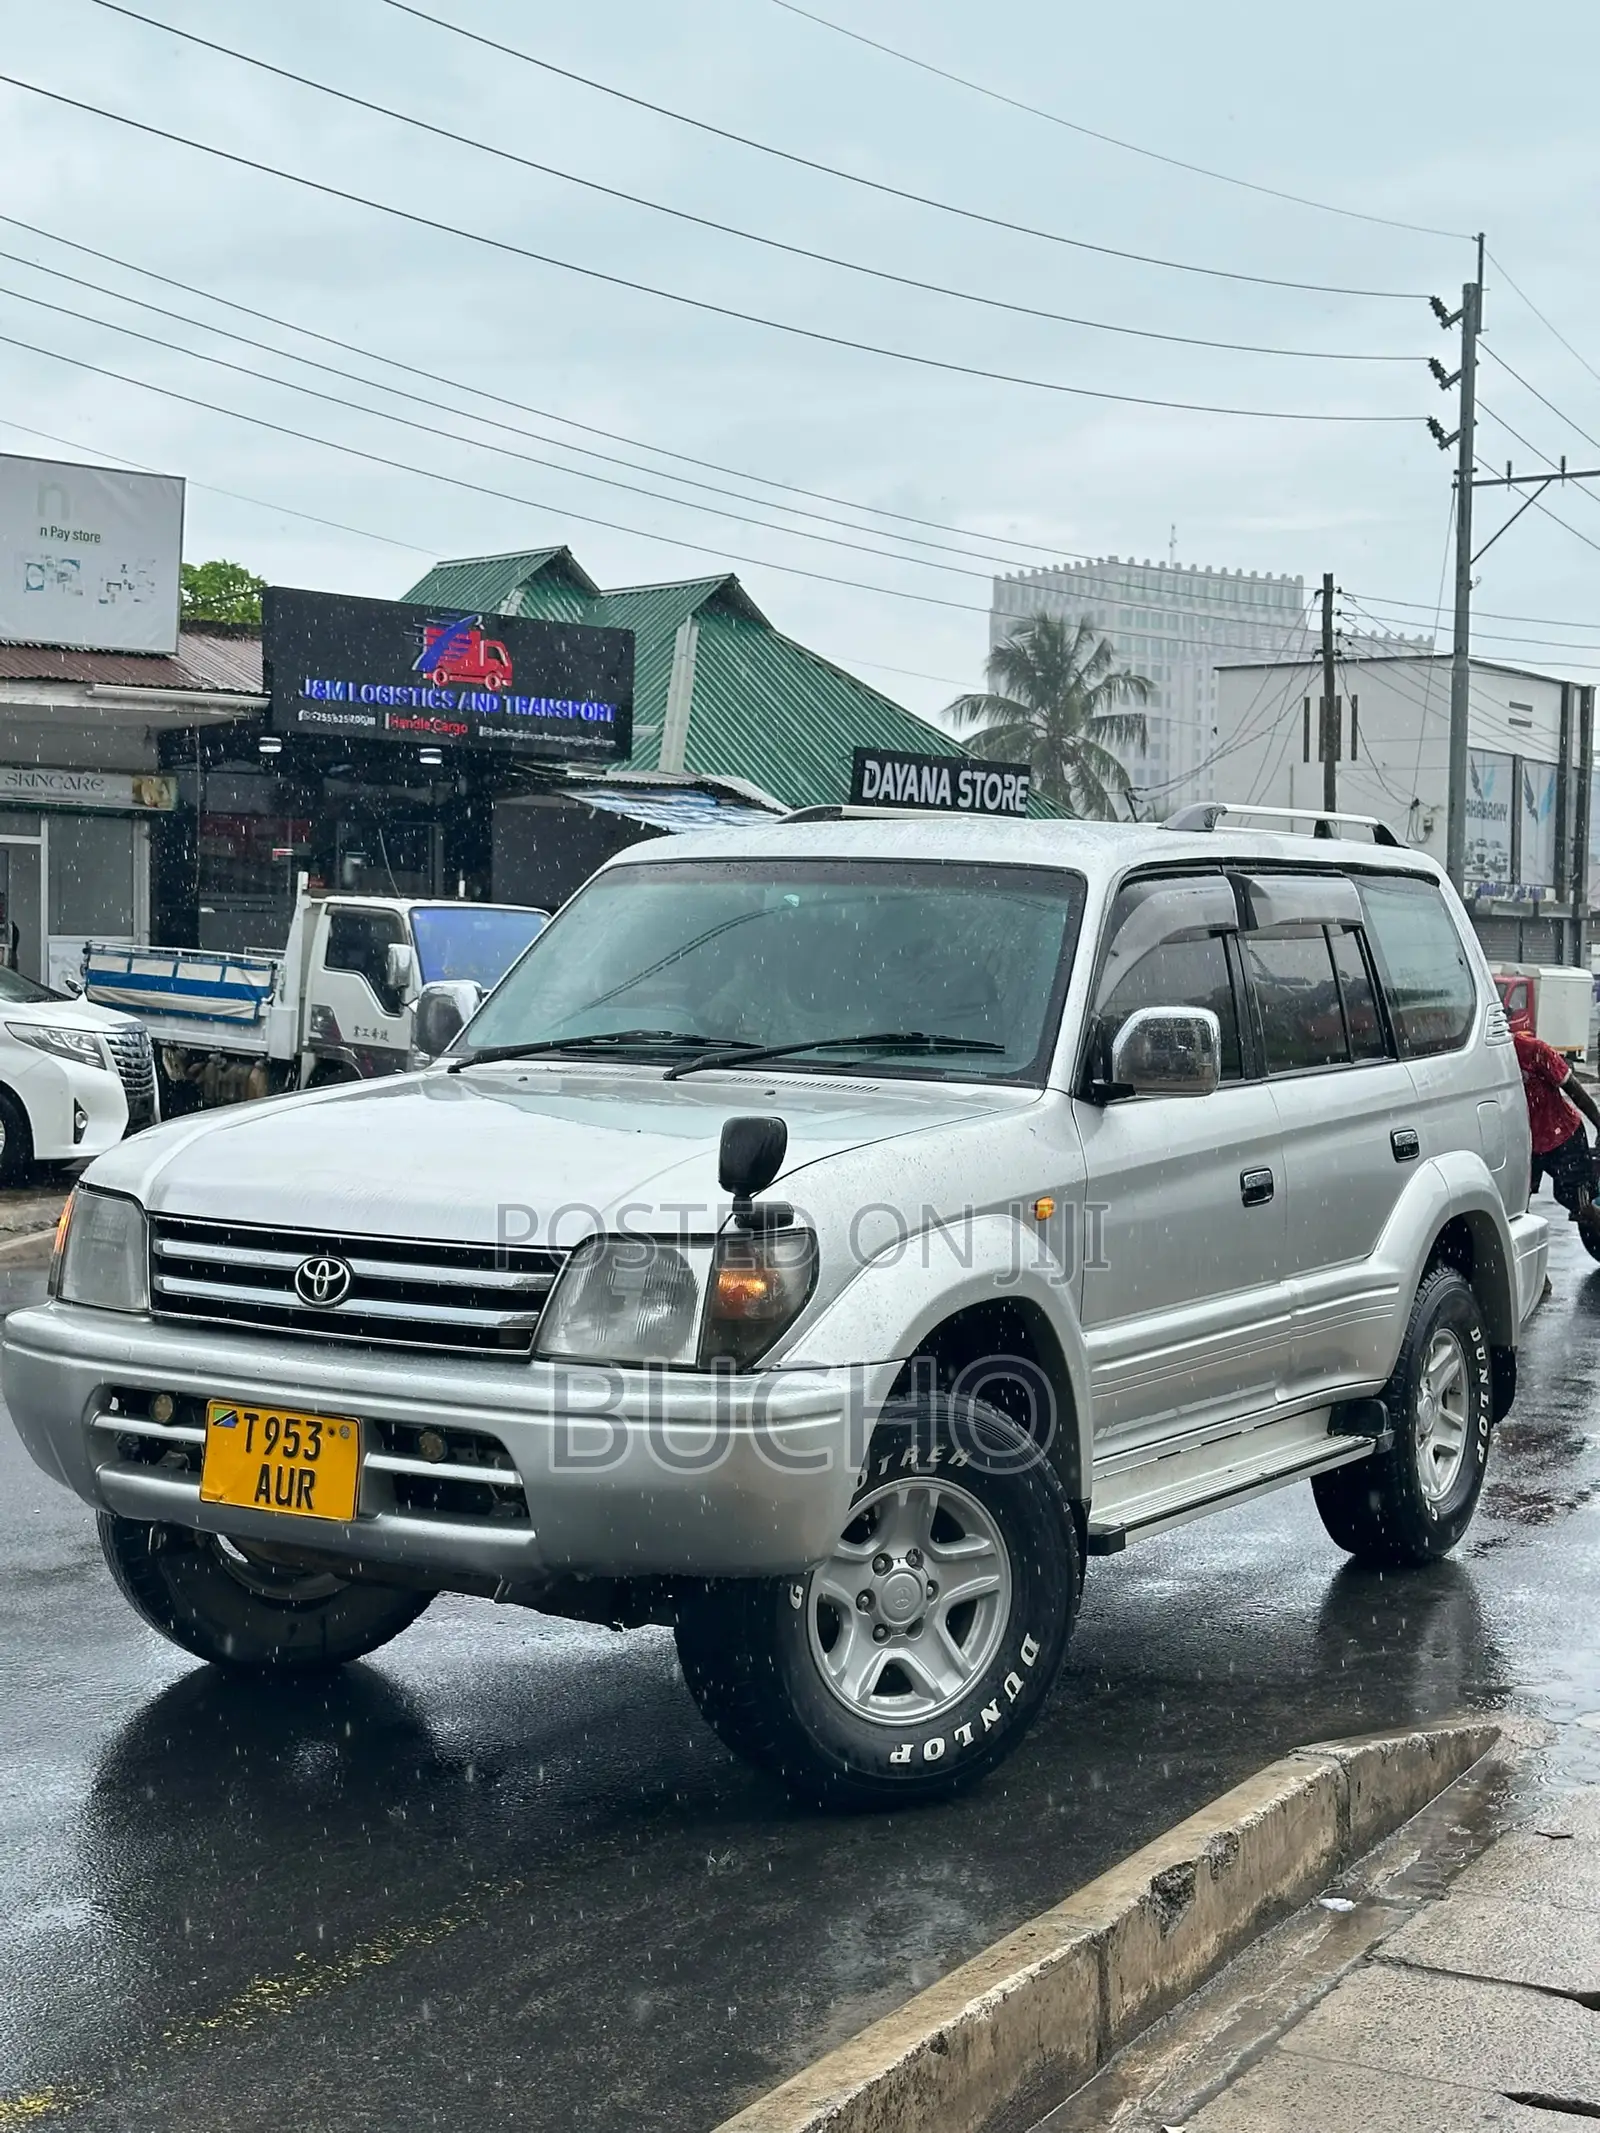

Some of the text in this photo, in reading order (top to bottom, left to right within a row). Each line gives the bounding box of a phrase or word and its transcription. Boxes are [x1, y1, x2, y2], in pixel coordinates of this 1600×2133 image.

[50, 525, 71, 542] Pay
[72, 530, 101, 544] store
[299, 678, 617, 723] J&M LOGISTICS AND TRANSPORT
[432, 718, 468, 736] Cargo
[5, 772, 105, 792] SKINCARE
[861, 759, 1030, 813] DAYANA STORE
[1469, 1325, 1490, 1465] DUNLOP
[243, 1412, 324, 1462] T 953
[254, 1463, 316, 1511] AUR
[889, 1632, 1041, 1764] DUNLOP
